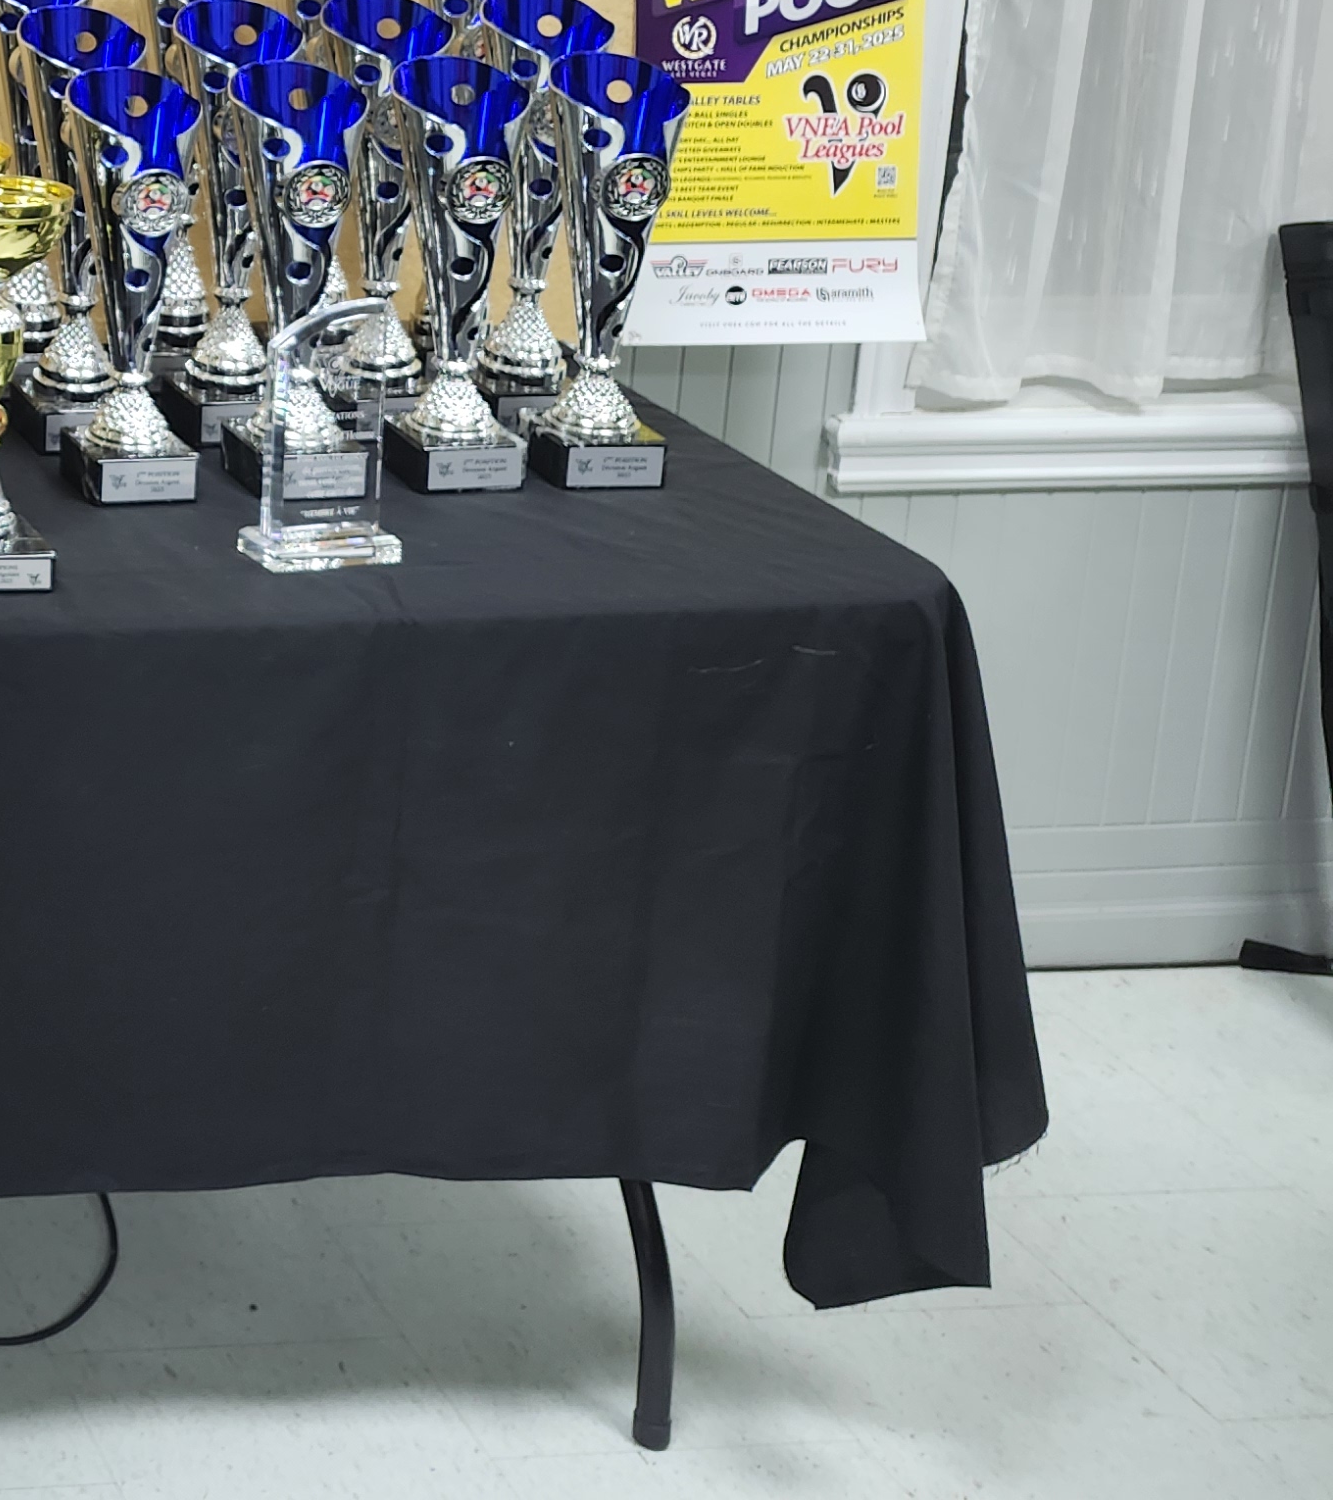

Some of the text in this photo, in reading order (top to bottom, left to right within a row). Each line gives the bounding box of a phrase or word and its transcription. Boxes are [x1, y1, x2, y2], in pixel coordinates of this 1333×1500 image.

[780, 7, 905, 53] CHAMPIONSHIPS
[786, 113, 905, 138] VNEA Pool
[800, 140, 885, 166] Leagues
